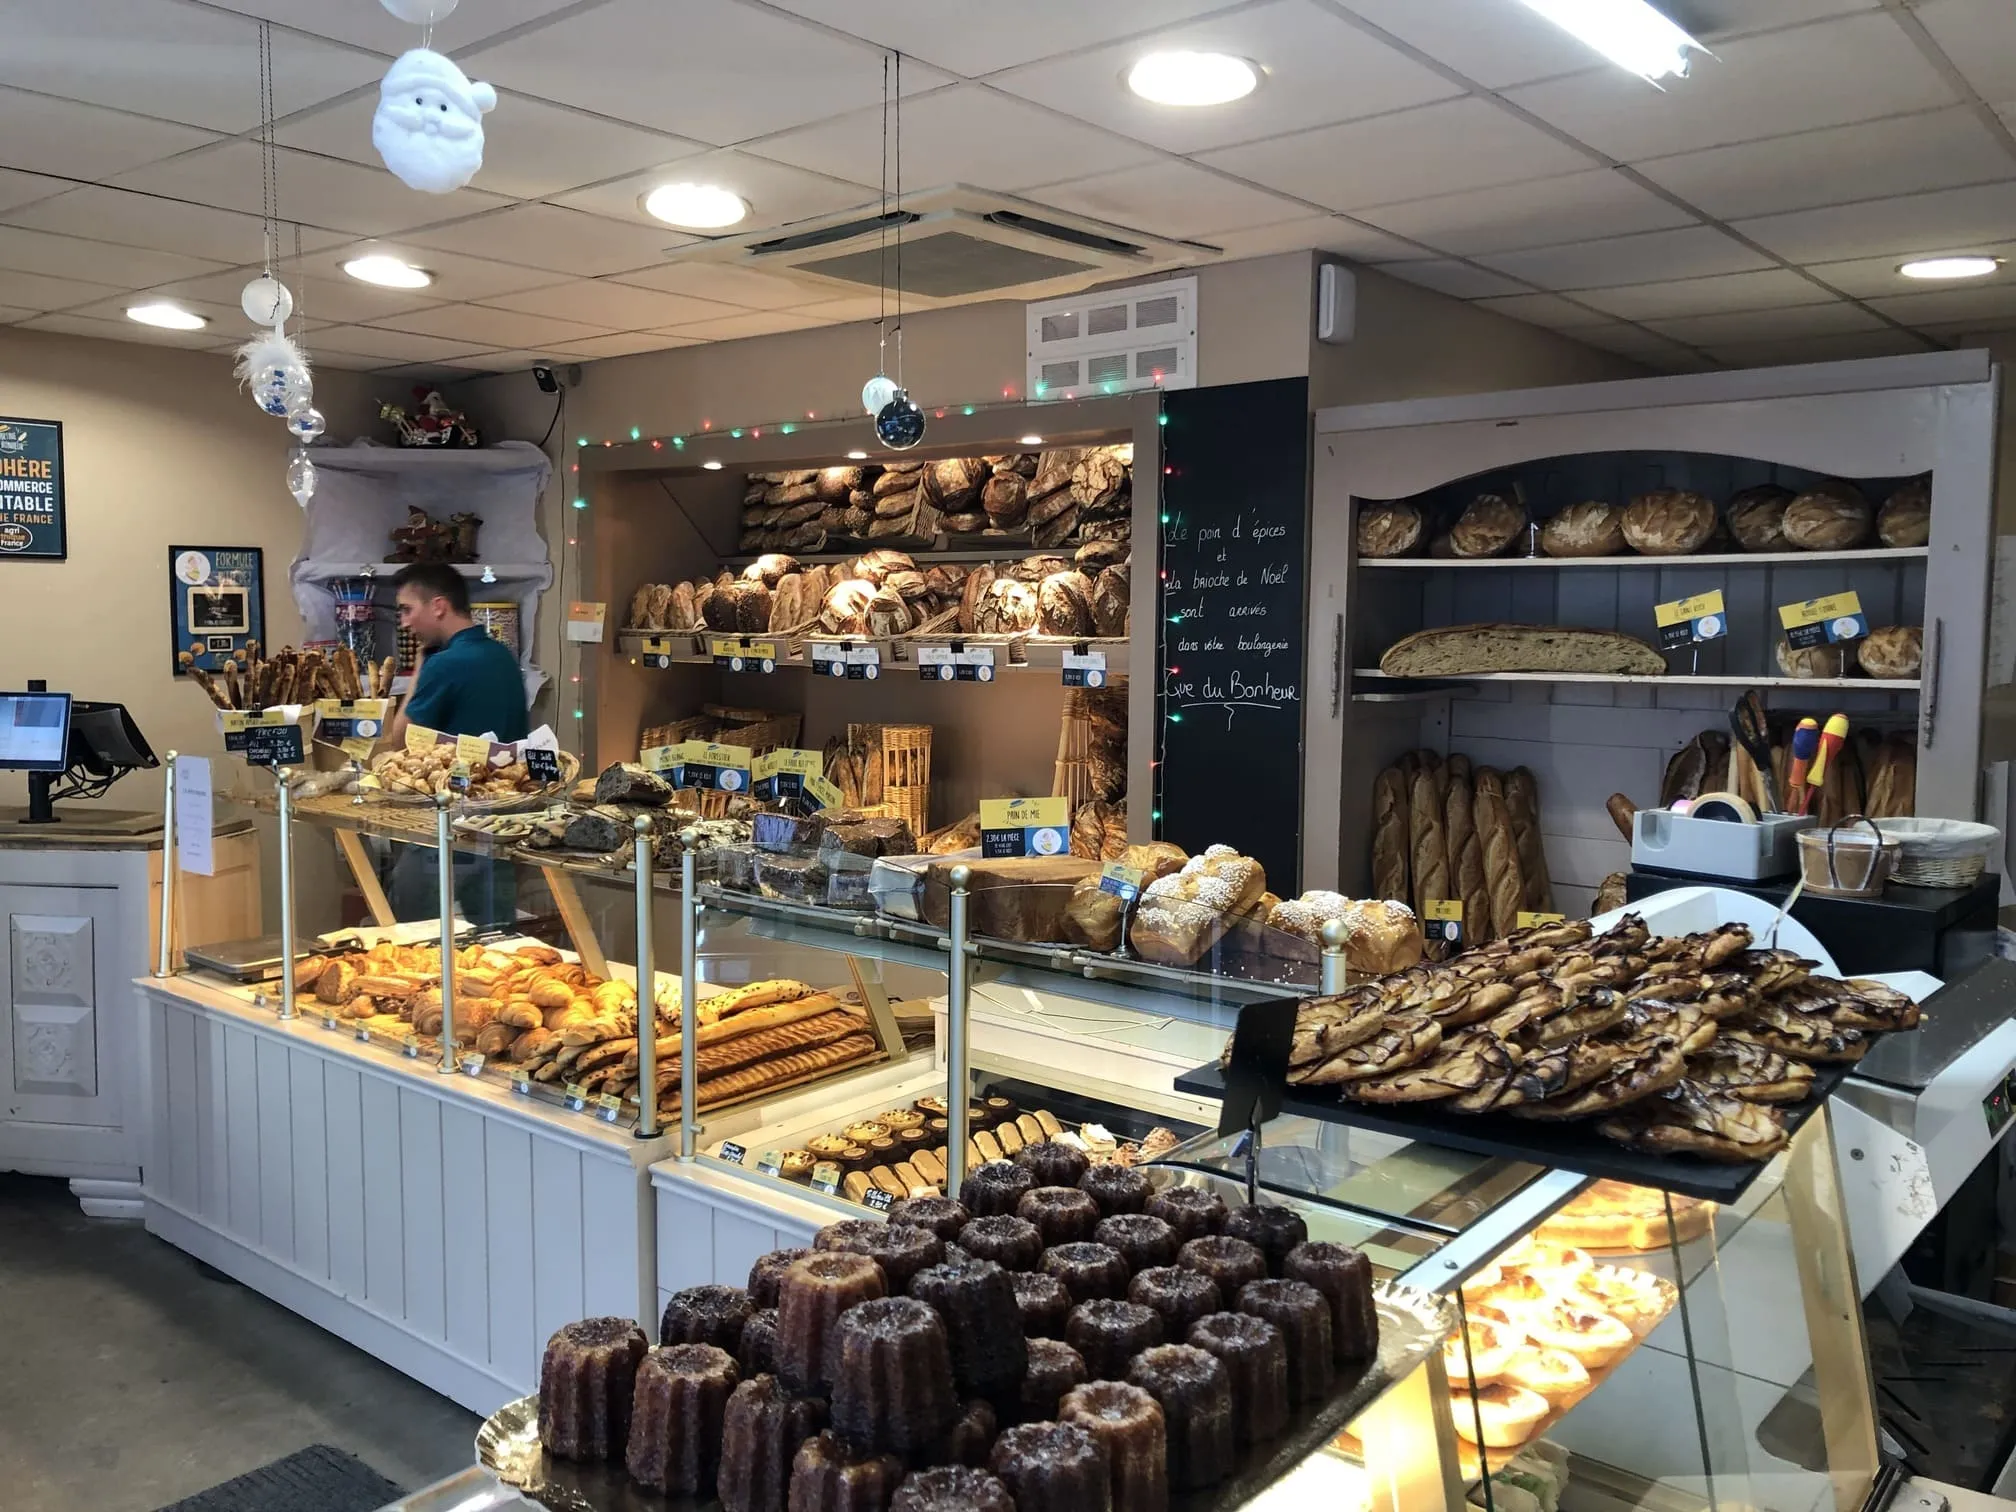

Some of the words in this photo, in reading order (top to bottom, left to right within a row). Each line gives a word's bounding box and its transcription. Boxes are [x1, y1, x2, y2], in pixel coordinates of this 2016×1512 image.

[14, 514, 53, 525] FRANCE
[216, 552, 254, 569] FORMULE
[1216, 547, 1227, 562] et
[1192, 569, 1229, 590] brioche
[1236, 569, 1248, 586] de
[1260, 562, 1288, 585] Noël
[1178, 596, 1204, 618] sont
[1229, 602, 1267, 617] arrivés
[1178, 636, 1199, 651] dans
[1238, 632, 1288, 657] boulangerie
[1202, 676, 1224, 698] du
[1230, 670, 1300, 700] Bonheur
[1007, 810, 1020, 819] PAIN
[1021, 810, 1028, 819] DE
[1030, 808, 1040, 818] MIE
